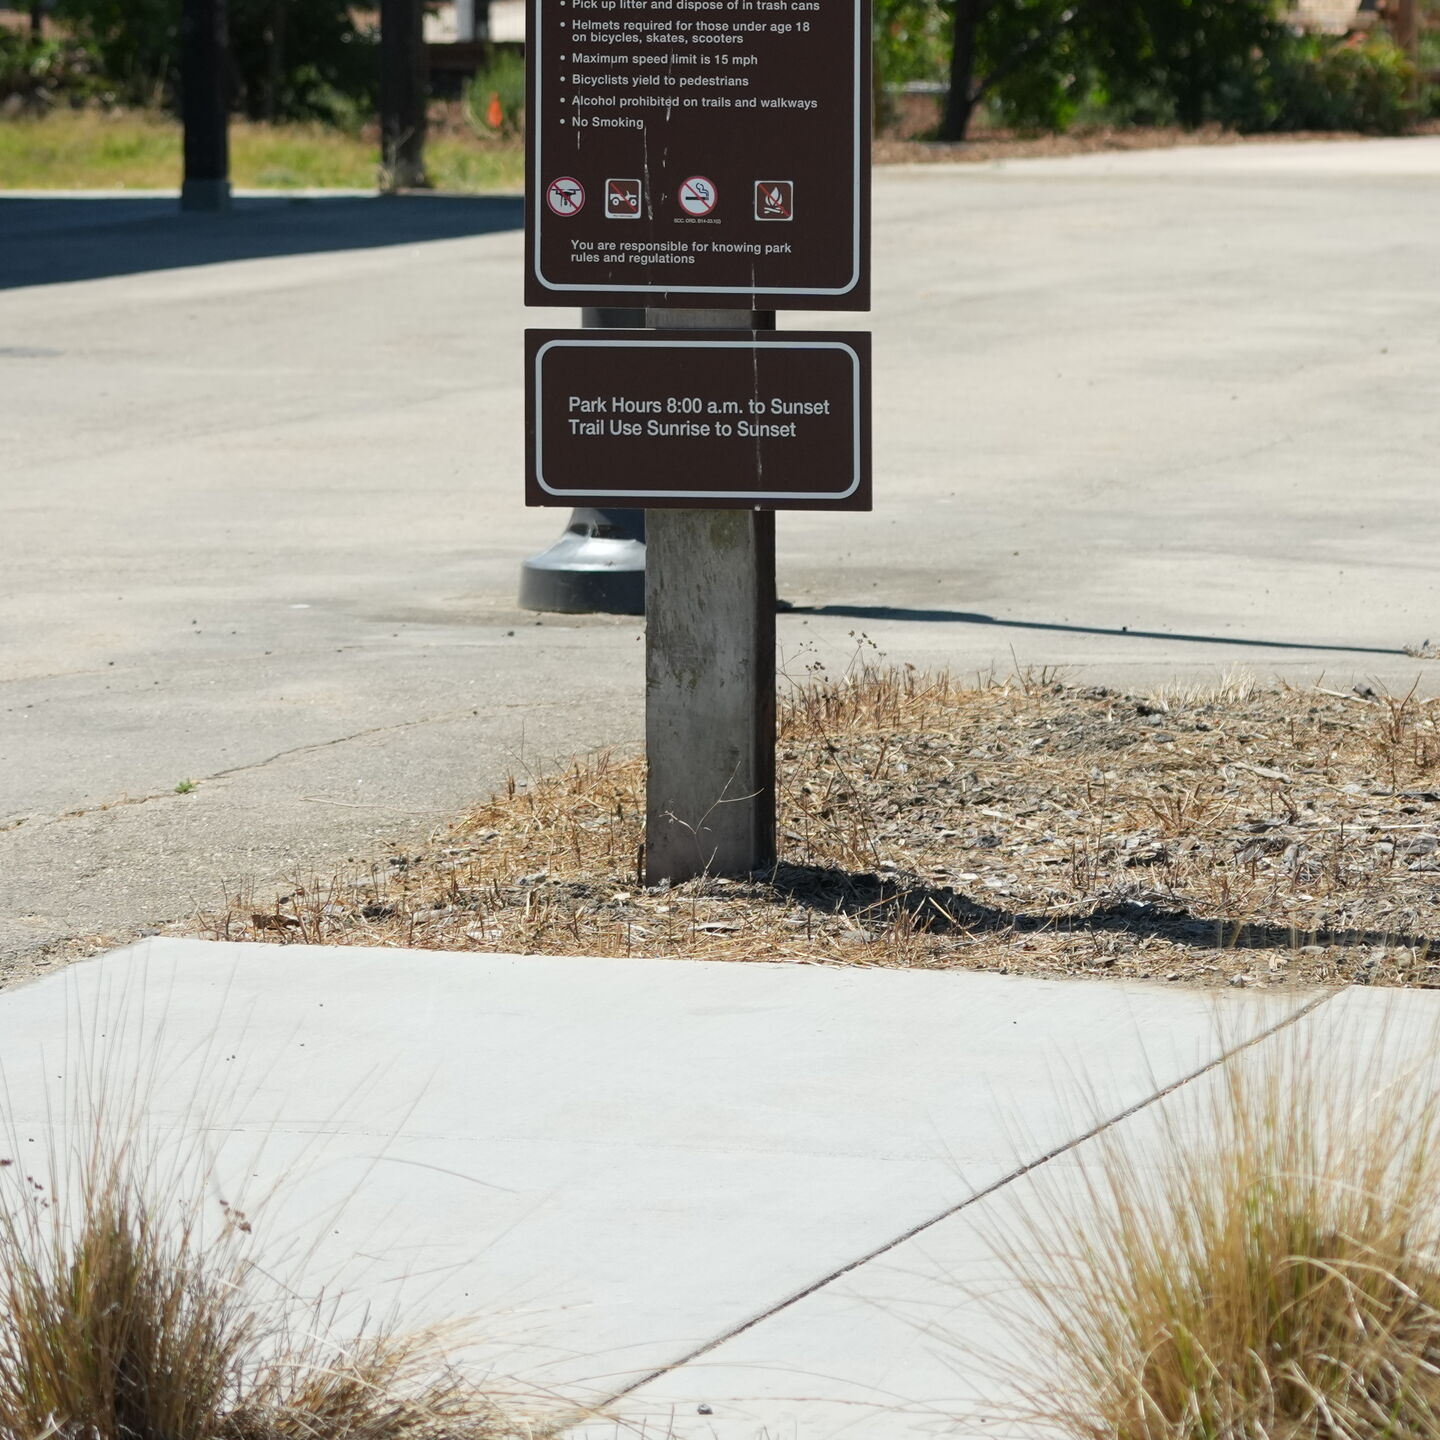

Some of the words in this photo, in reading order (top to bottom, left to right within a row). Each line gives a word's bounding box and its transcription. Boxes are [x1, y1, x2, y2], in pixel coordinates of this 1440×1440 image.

[601, 0, 617, 11] up
[650, 0, 673, 10] and
[676, 0, 724, 12] dispose
[726, 0, 739, 10] of
[742, 0, 753, 10] in
[756, 0, 788, 11] trash
[790, 2, 820, 11] cans
[572, 19, 620, 31] Helmets
[623, 20, 673, 34] required
[675, 20, 693, 31] for
[695, 20, 729, 32] those
[732, 21, 767, 32] under
[769, 23, 793, 35] age
[795, 21, 810, 32] 18
[571, 33, 587, 42] on
[590, 31, 643, 45] bicycles,
[646, 32, 689, 45] skates,
[691, 34, 744, 44] scooters
[572, 52, 629, 64] Maximum
[632, 54, 669, 66] speed
[670, 53, 698, 65] limit
[700, 54, 711, 65] is
[714, 54, 729, 65] 15
[732, 54, 758, 66] mph
[572, 73, 629, 87] Bicyclists
[632, 74, 660, 88] yield
[663, 75, 676, 86] to
[679, 75, 749, 88] pedestrians
[571, 95, 616, 108] Alcohol
[619, 95, 680, 110] prohibited
[683, 98, 698, 107] on
[701, 96, 732, 108] trails
[734, 97, 757, 108] and
[760, 97, 818, 111] walkways
[571, 115, 589, 127] No
[591, 116, 644, 130] Smoking
[570, 239, 594, 251] You
[597, 241, 617, 251] are
[619, 240, 689, 254] responsible
[691, 241, 709, 252] for
[711, 241, 762, 256] knowing
[764, 242, 792, 255] park
[570, 252, 600, 263] rules
[603, 252, 626, 263] and
[628, 252, 696, 266] regulations
[569, 397, 607, 412] Park
[612, 397, 662, 413] Hours
[667, 398, 702, 413] 8:00
[707, 402, 743, 413] a.m.
[749, 399, 765, 414] to
[771, 398, 829, 414] Sunset
[569, 419, 604, 435] Trail
[610, 420, 642, 435] Use
[647, 420, 710, 436] Sunrise
[715, 422, 732, 436] to
[737, 421, 796, 437] Sunset
